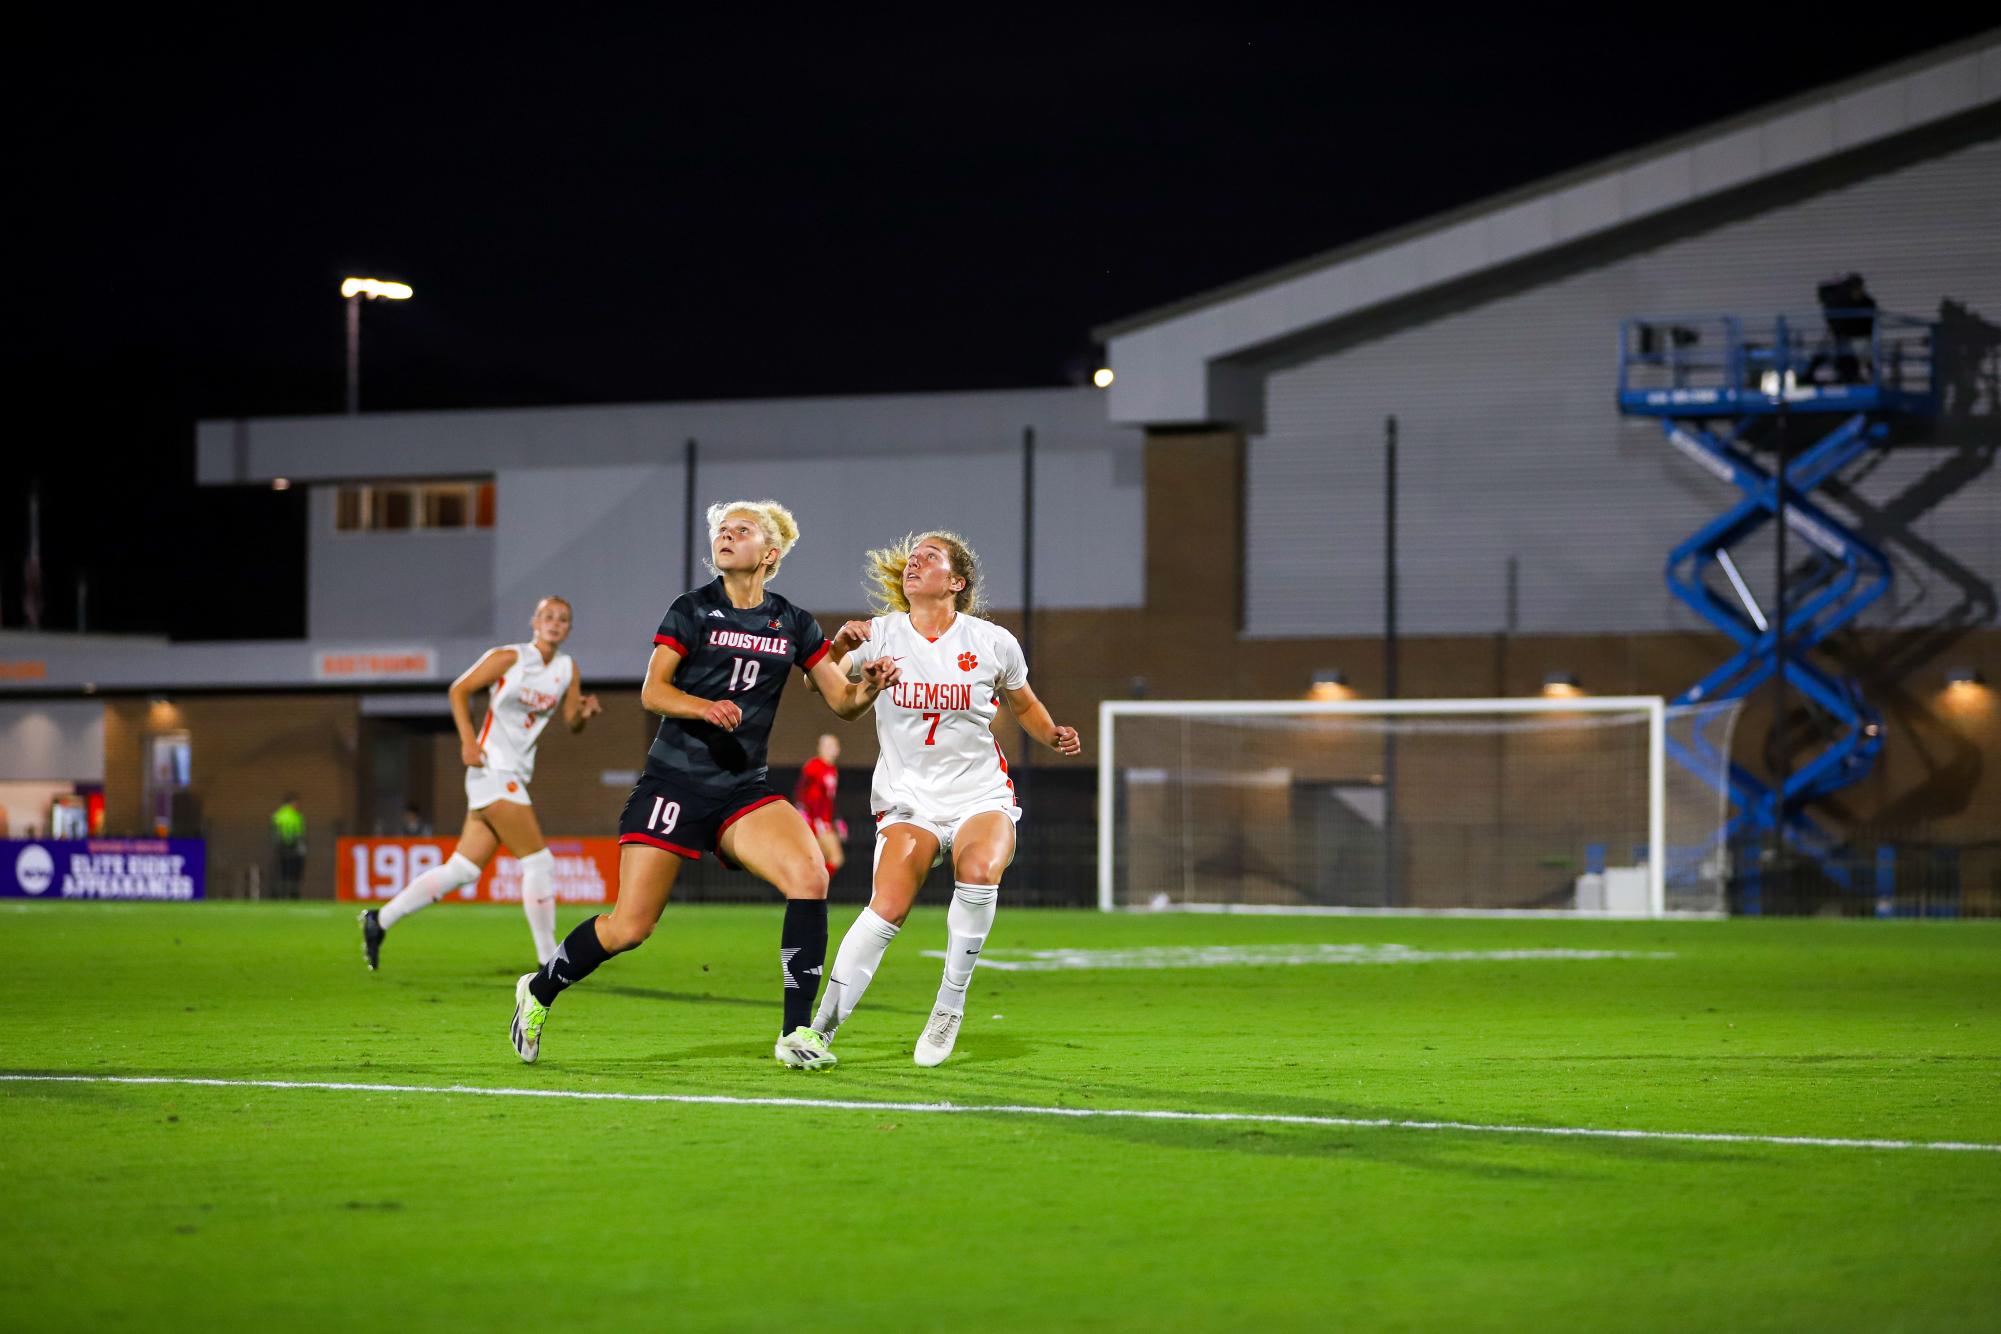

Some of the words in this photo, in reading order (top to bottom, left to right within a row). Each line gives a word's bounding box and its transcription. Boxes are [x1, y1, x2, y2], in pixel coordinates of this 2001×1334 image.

[708, 630, 788, 655] LOUISVILLE
[728, 656, 761, 691] 19
[892, 681, 972, 711] CLEMSON
[922, 712, 941, 746] 7
[647, 796, 681, 835] 19
